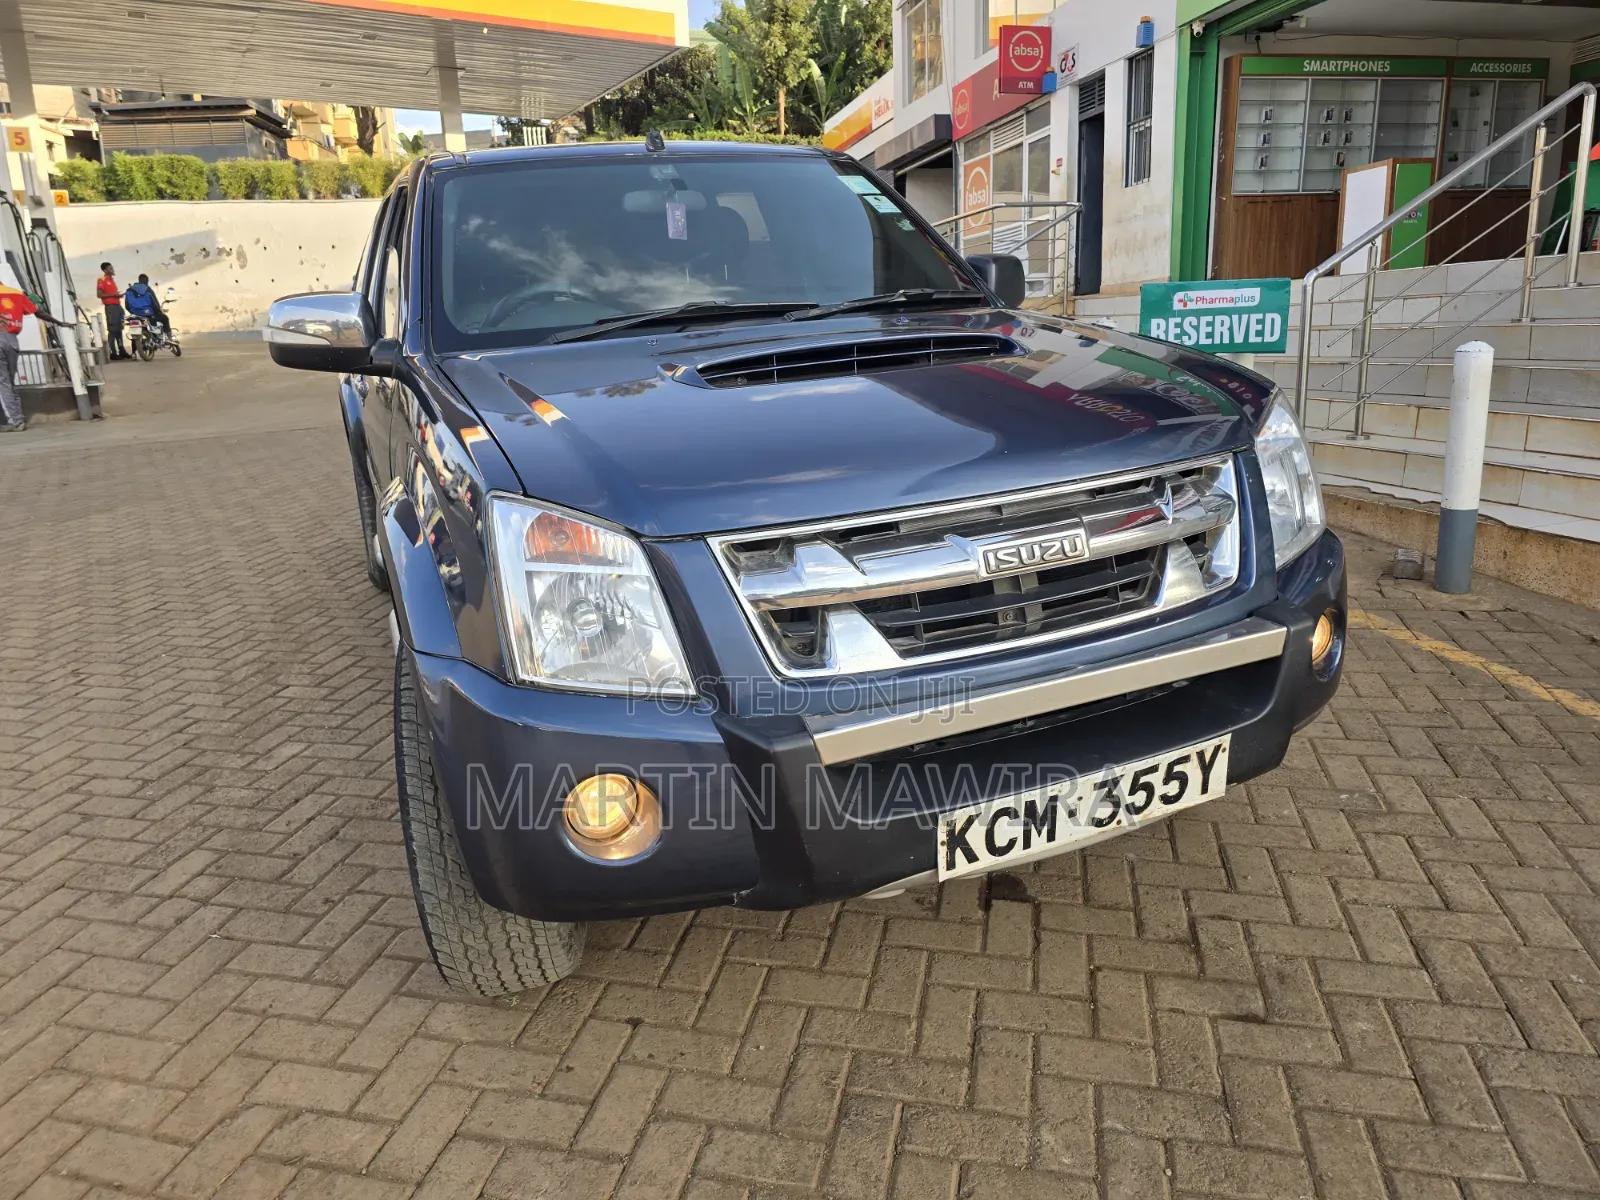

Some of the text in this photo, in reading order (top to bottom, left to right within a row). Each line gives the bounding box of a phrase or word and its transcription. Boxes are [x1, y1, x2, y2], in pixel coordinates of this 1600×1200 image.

[1014, 43, 1039, 56] absa
[1303, 59, 1391, 72] SMARTPHONES
[1470, 62, 1532, 73] ACCESSORIES
[1018, 81, 1034, 89] ATM
[956, 102, 968, 117] absa
[14, 132, 26, 146] 5
[56, 195, 65, 204] 2
[968, 187, 986, 206] absa
[1195, 294, 1256, 305] Pharmaplus
[1150, 313, 1281, 345] RESERVED
[986, 537, 1082, 571] ISUZU
[946, 743, 1223, 872] KCM 355Y
